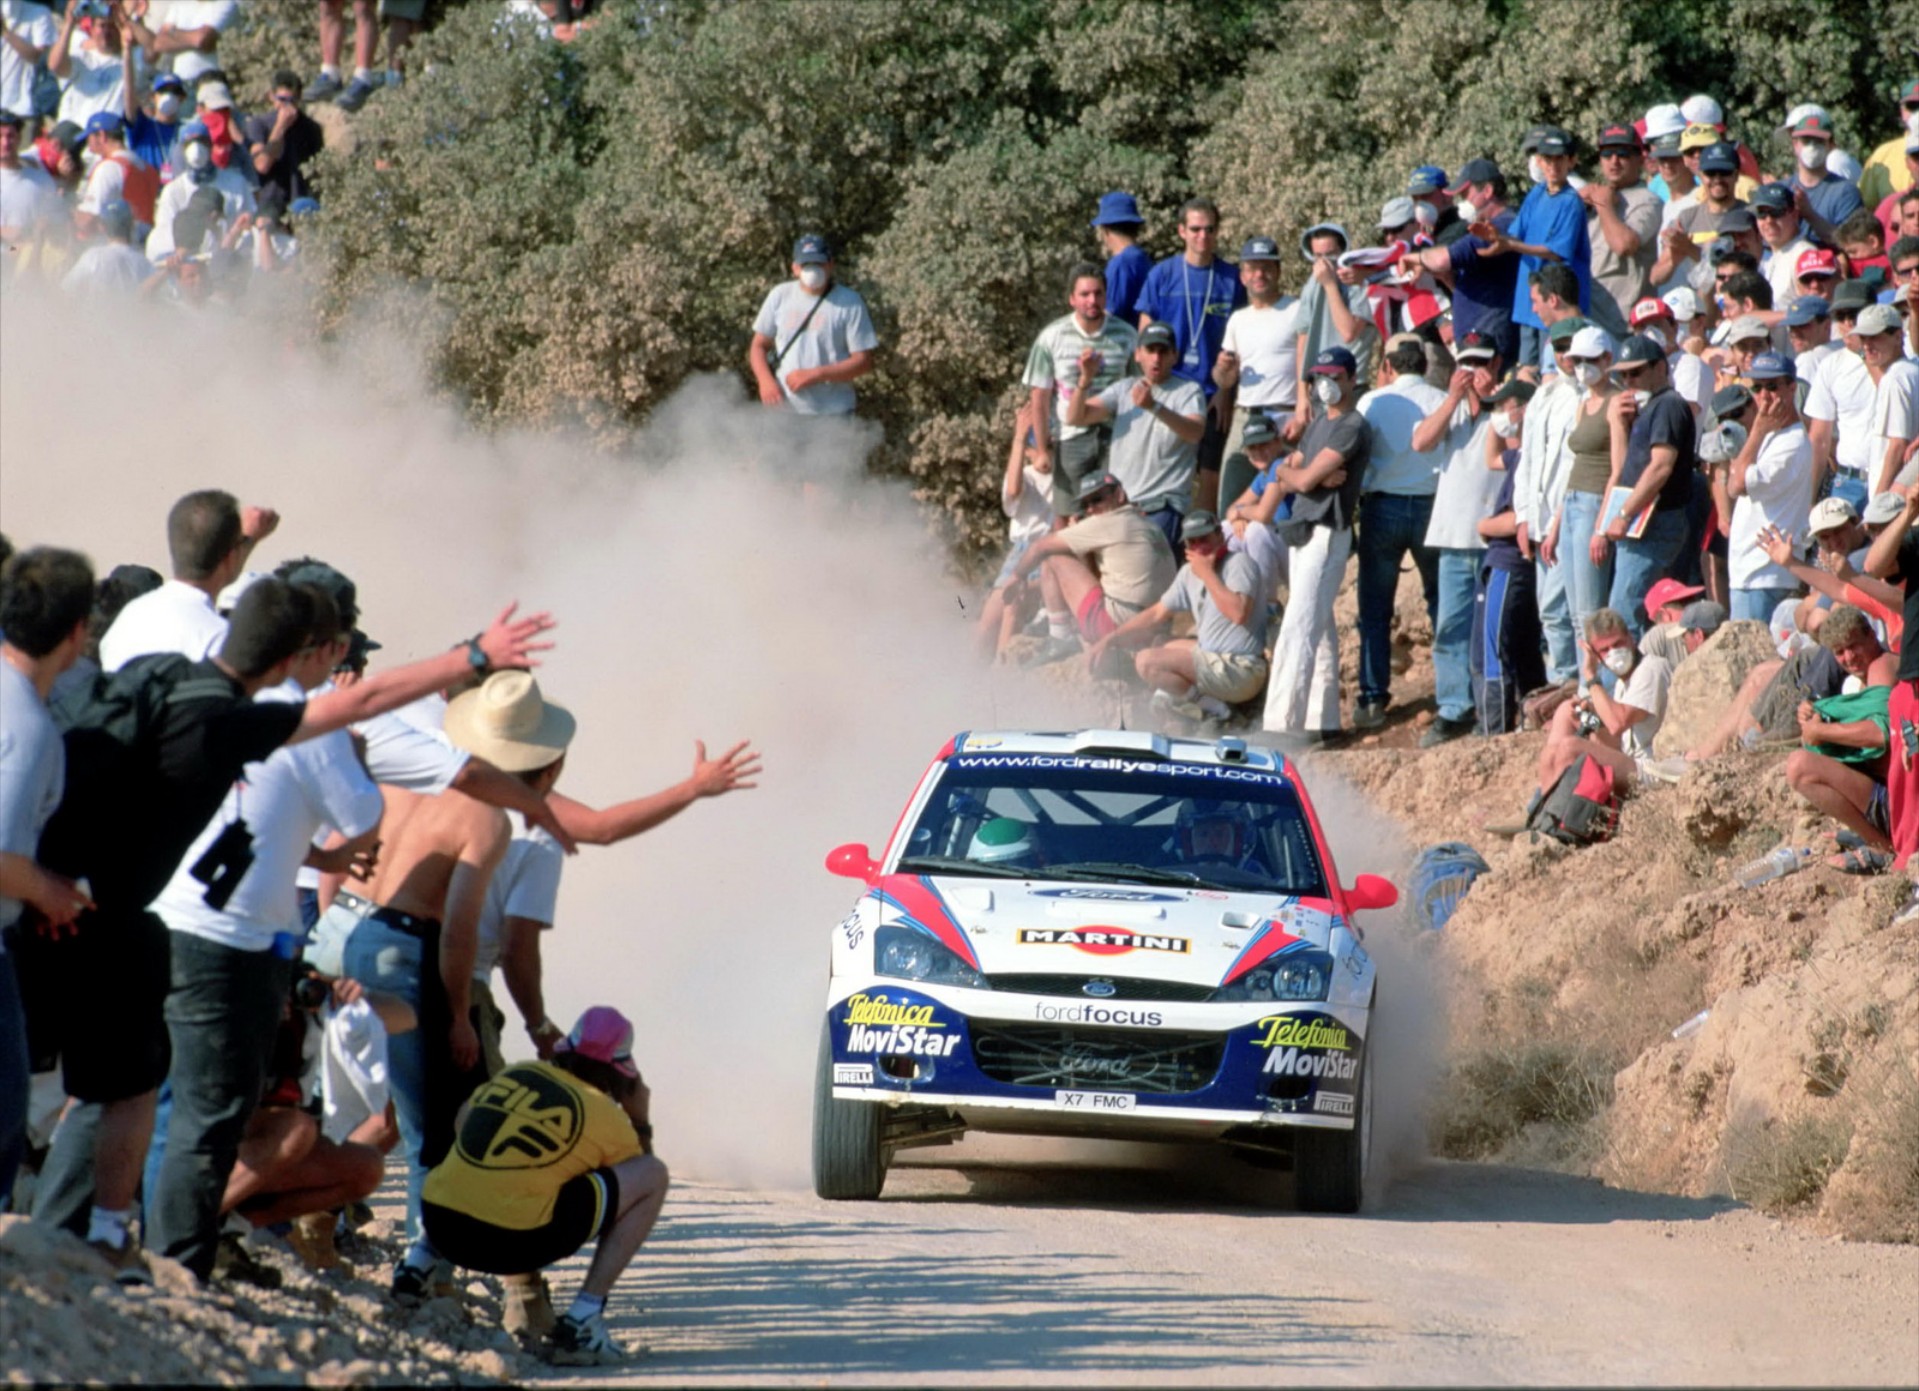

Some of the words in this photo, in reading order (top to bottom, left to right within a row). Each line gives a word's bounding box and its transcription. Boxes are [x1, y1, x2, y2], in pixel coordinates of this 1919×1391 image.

[959, 754, 1283, 784] www.fordrallyesport.com
[1060, 888, 1154, 901] Ford
[1026, 931, 1182, 951] MARTINI
[1035, 1001, 1163, 1027] fordfocus
[847, 1023, 961, 1056] MoviStar
[833, 1062, 874, 1084] PIRELLI
[1262, 1046, 1357, 1079] MoviStar
[469, 1076, 572, 1145] FILA
[1064, 1093, 1084, 1106] X7
[1093, 1095, 1127, 1109] FMC
[1313, 1090, 1354, 1114] PIRELLI
